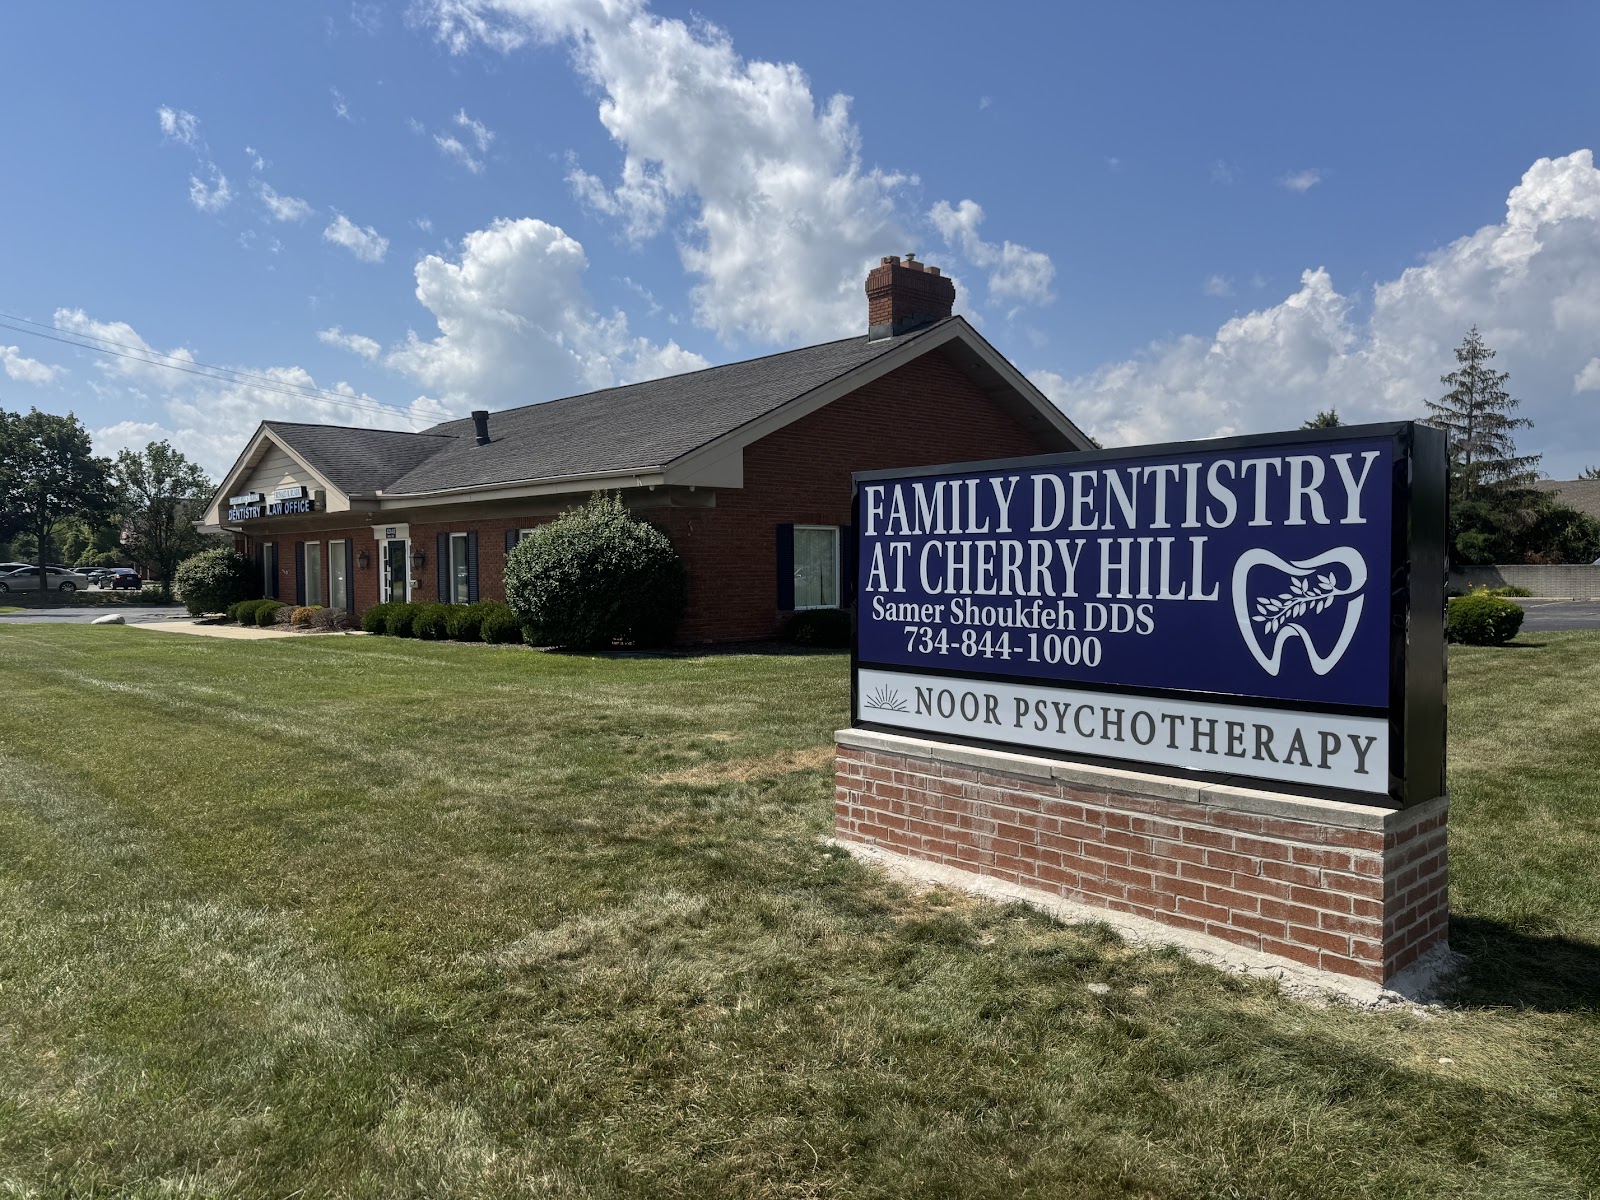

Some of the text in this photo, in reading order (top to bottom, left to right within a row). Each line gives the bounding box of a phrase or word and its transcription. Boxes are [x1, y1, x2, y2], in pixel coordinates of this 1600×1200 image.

[228, 506, 260, 520] DENTISTRY
[269, 500, 310, 515] LAW OFFICE
[864, 451, 1380, 536] FAMILY DENTISTRY
[865, 536, 1220, 601] AT CHERRY HILL
[872, 595, 1155, 635] Samer Shoukfeh DDS
[904, 626, 1102, 667] 734-844-1000
[914, 686, 1378, 775] NOOR PSYCHOTHERAPY
